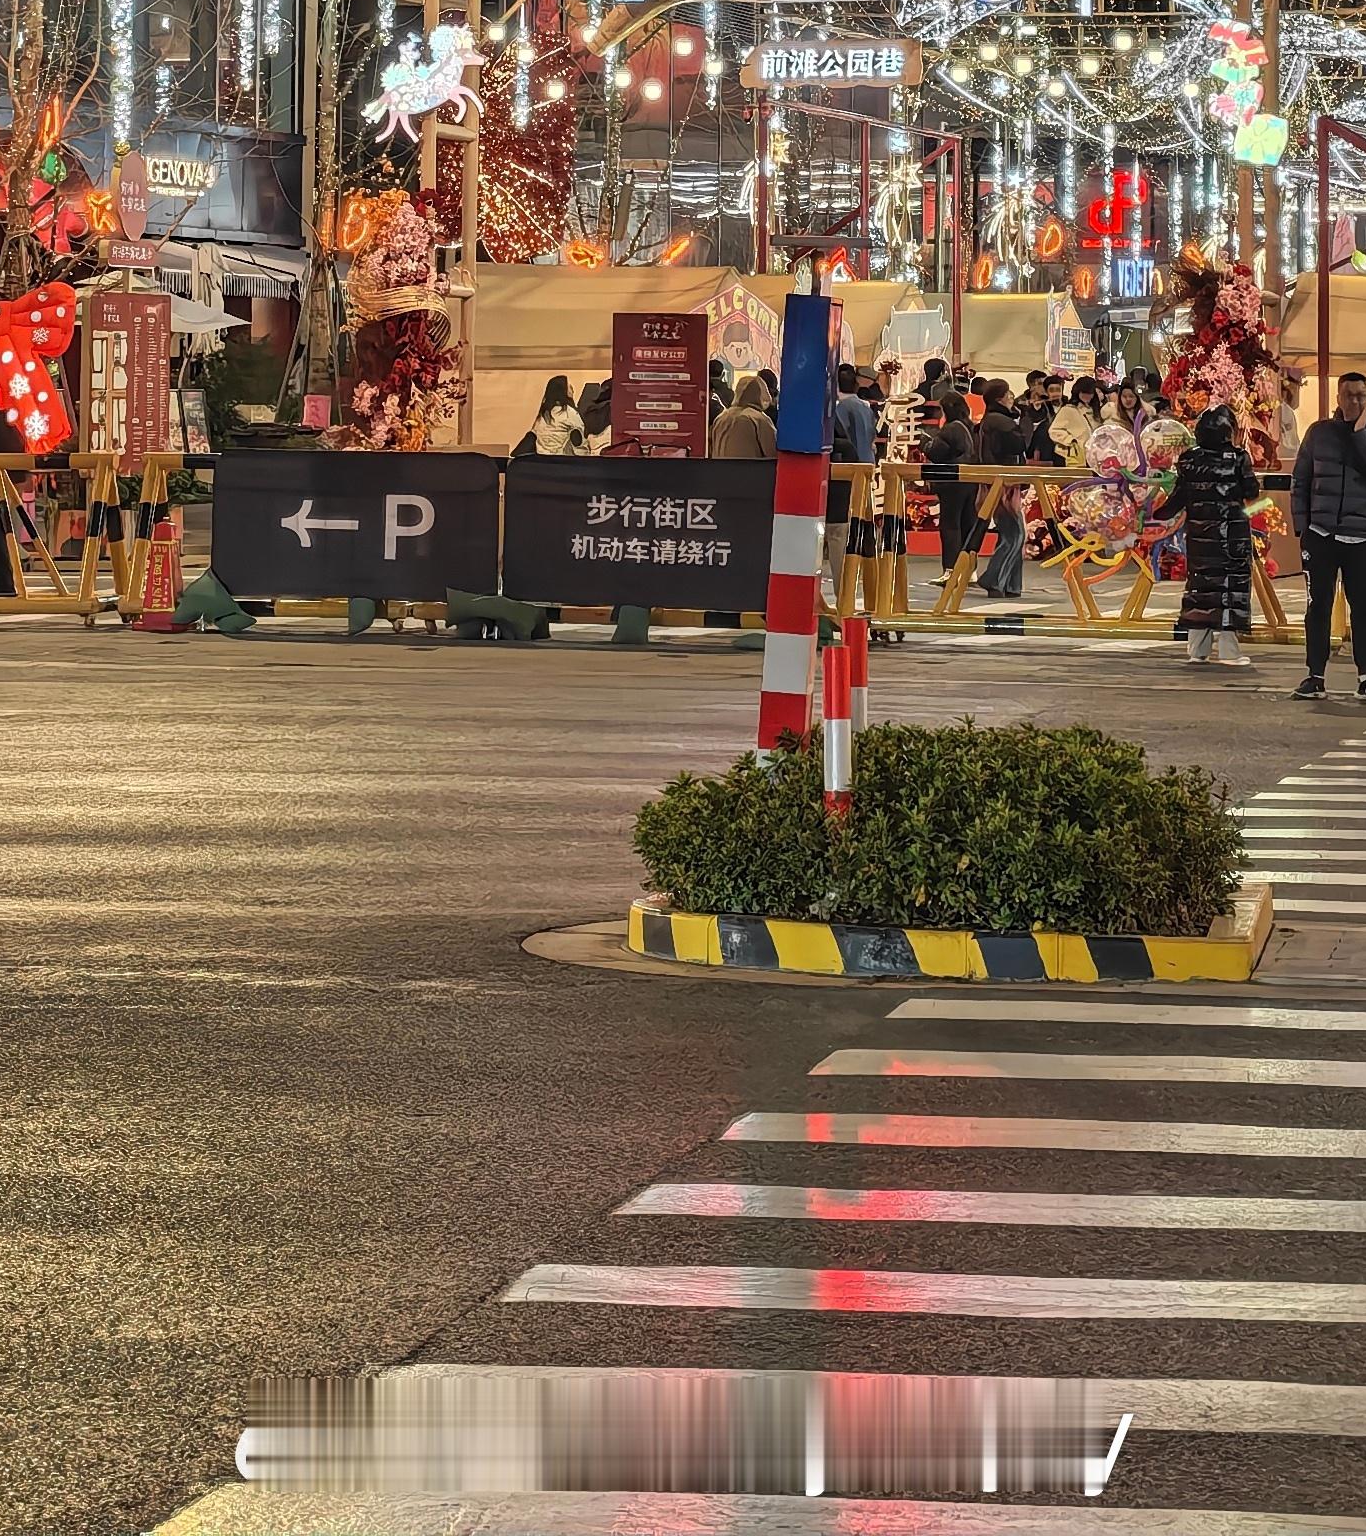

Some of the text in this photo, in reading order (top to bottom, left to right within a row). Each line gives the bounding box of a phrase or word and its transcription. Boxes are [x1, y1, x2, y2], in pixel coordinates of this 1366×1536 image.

[761, 48, 904, 80] 前滩公园巷
[146, 157, 205, 187] GENOVA
[705, 287, 779, 338] ELCOME
[384, 494, 435, 561] P
[587, 494, 718, 531] 步行街区
[570, 533, 732, 567] 机动车请绕行
